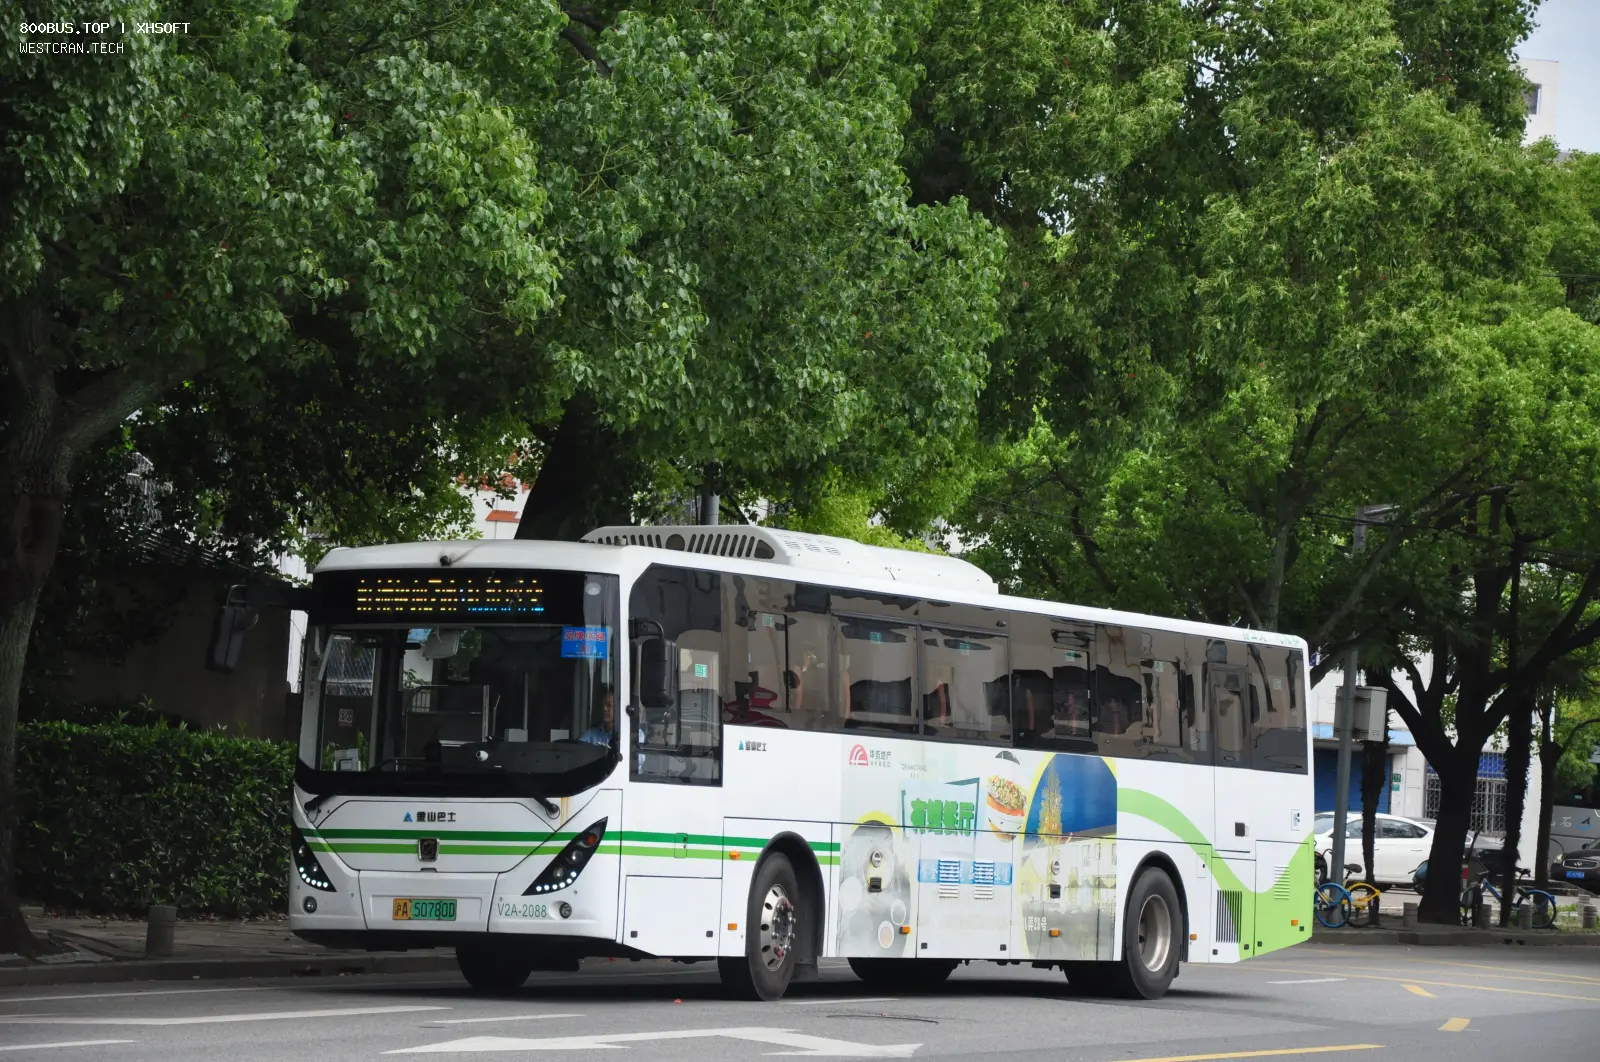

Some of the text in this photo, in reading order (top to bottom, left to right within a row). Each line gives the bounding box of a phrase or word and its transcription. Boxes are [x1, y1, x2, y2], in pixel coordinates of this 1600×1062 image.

[416, 811, 457, 823] 金山巴士
[498, 903, 547, 918] V2A-2088
